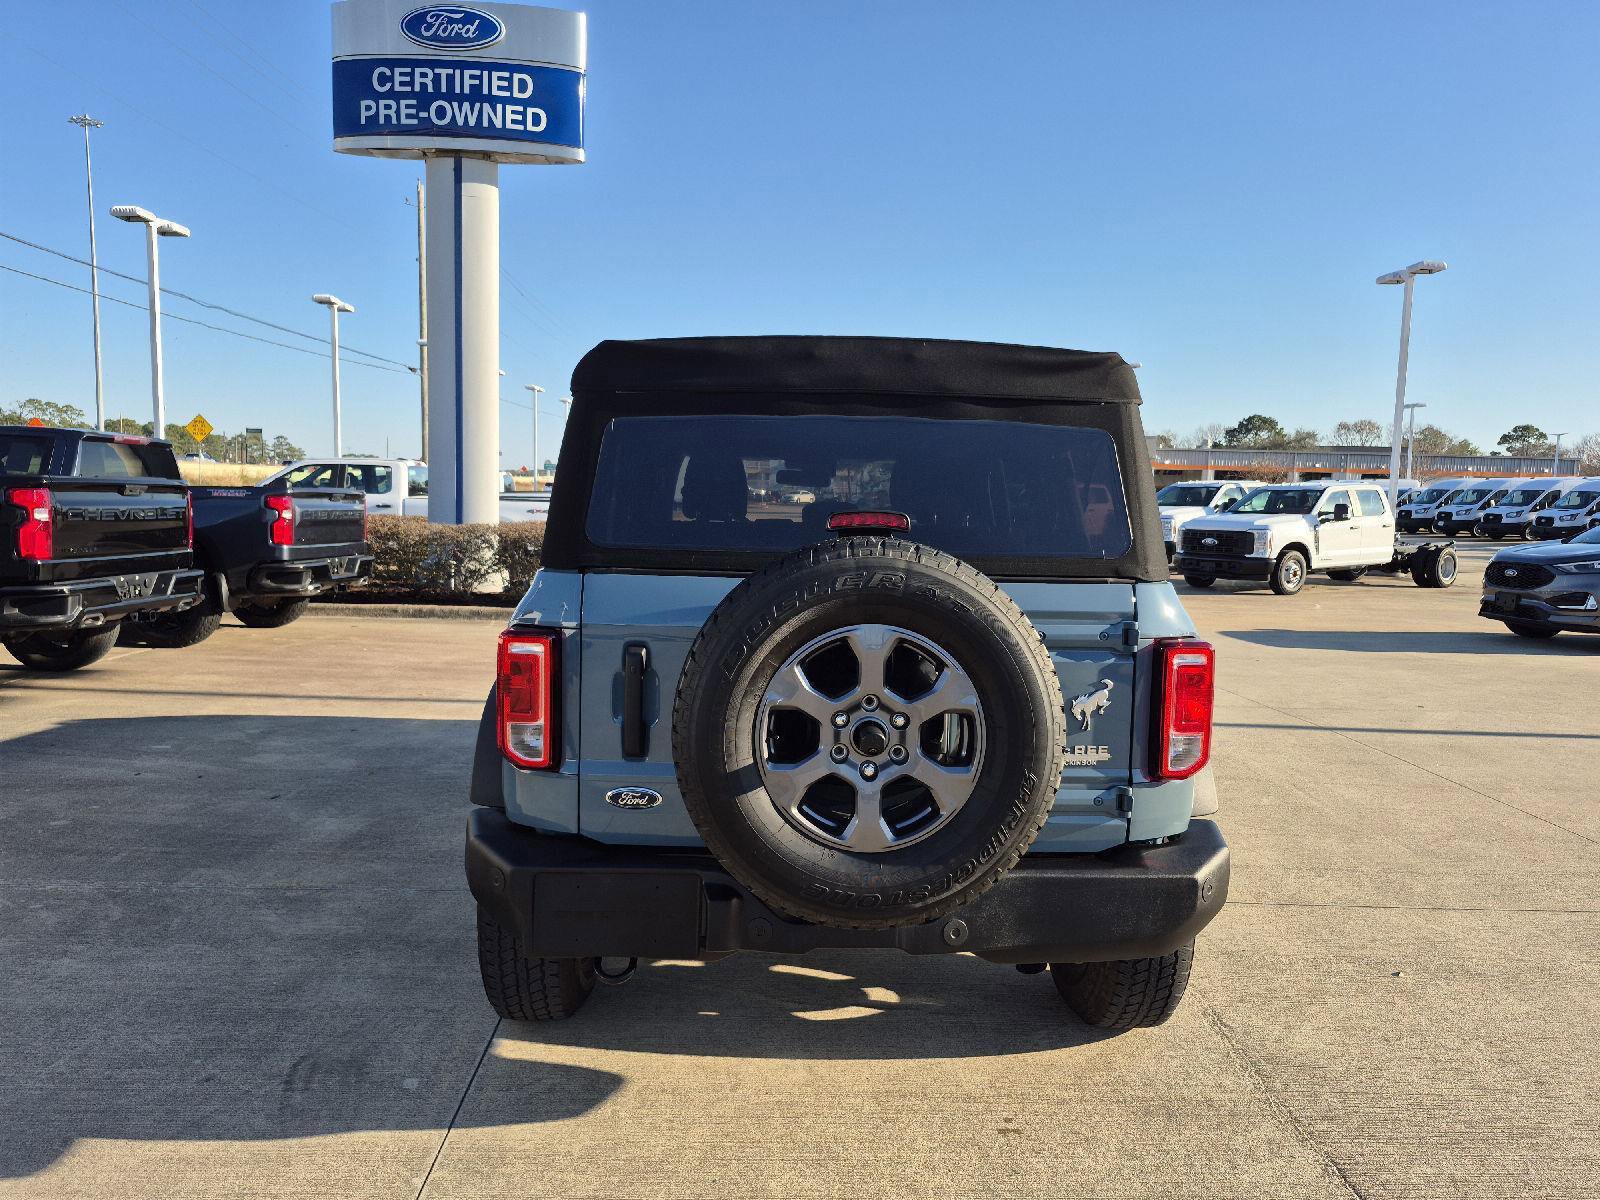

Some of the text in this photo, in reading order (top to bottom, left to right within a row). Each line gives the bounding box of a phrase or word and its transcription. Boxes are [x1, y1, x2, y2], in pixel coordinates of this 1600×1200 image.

[420, 11, 479, 38] Ford
[372, 66, 534, 99] CERTIFIED
[359, 99, 548, 132] PRE-OWNED
[66, 507, 185, 521] CHEVROLET
[618, 791, 649, 805] Ford
